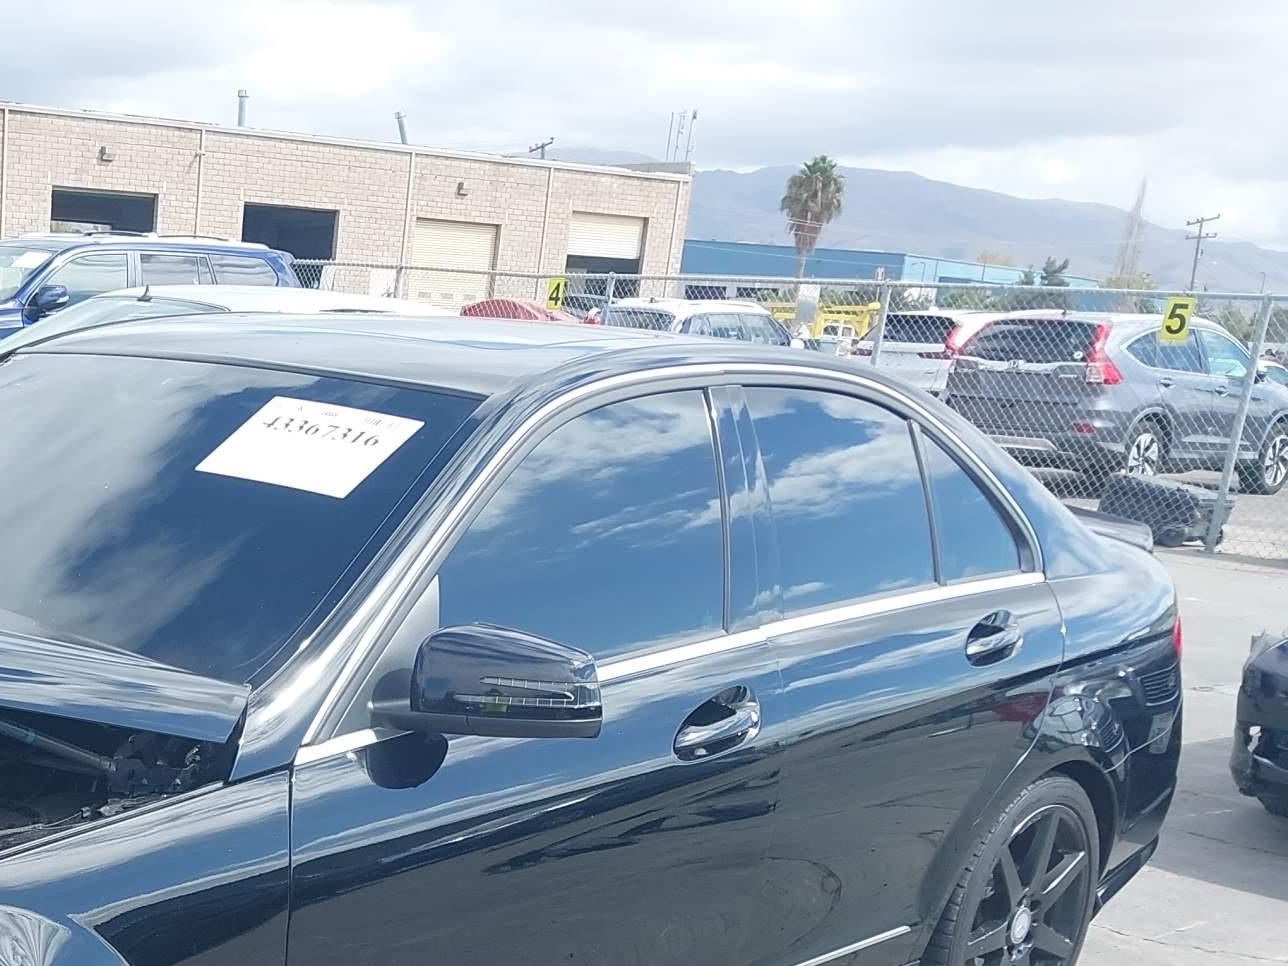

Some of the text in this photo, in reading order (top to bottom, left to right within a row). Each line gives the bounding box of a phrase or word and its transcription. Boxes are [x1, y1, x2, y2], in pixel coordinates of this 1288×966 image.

[549, 282, 561, 306] 4
[1165, 303, 1189, 335] 5
[263, 416, 379, 447] 43367316
